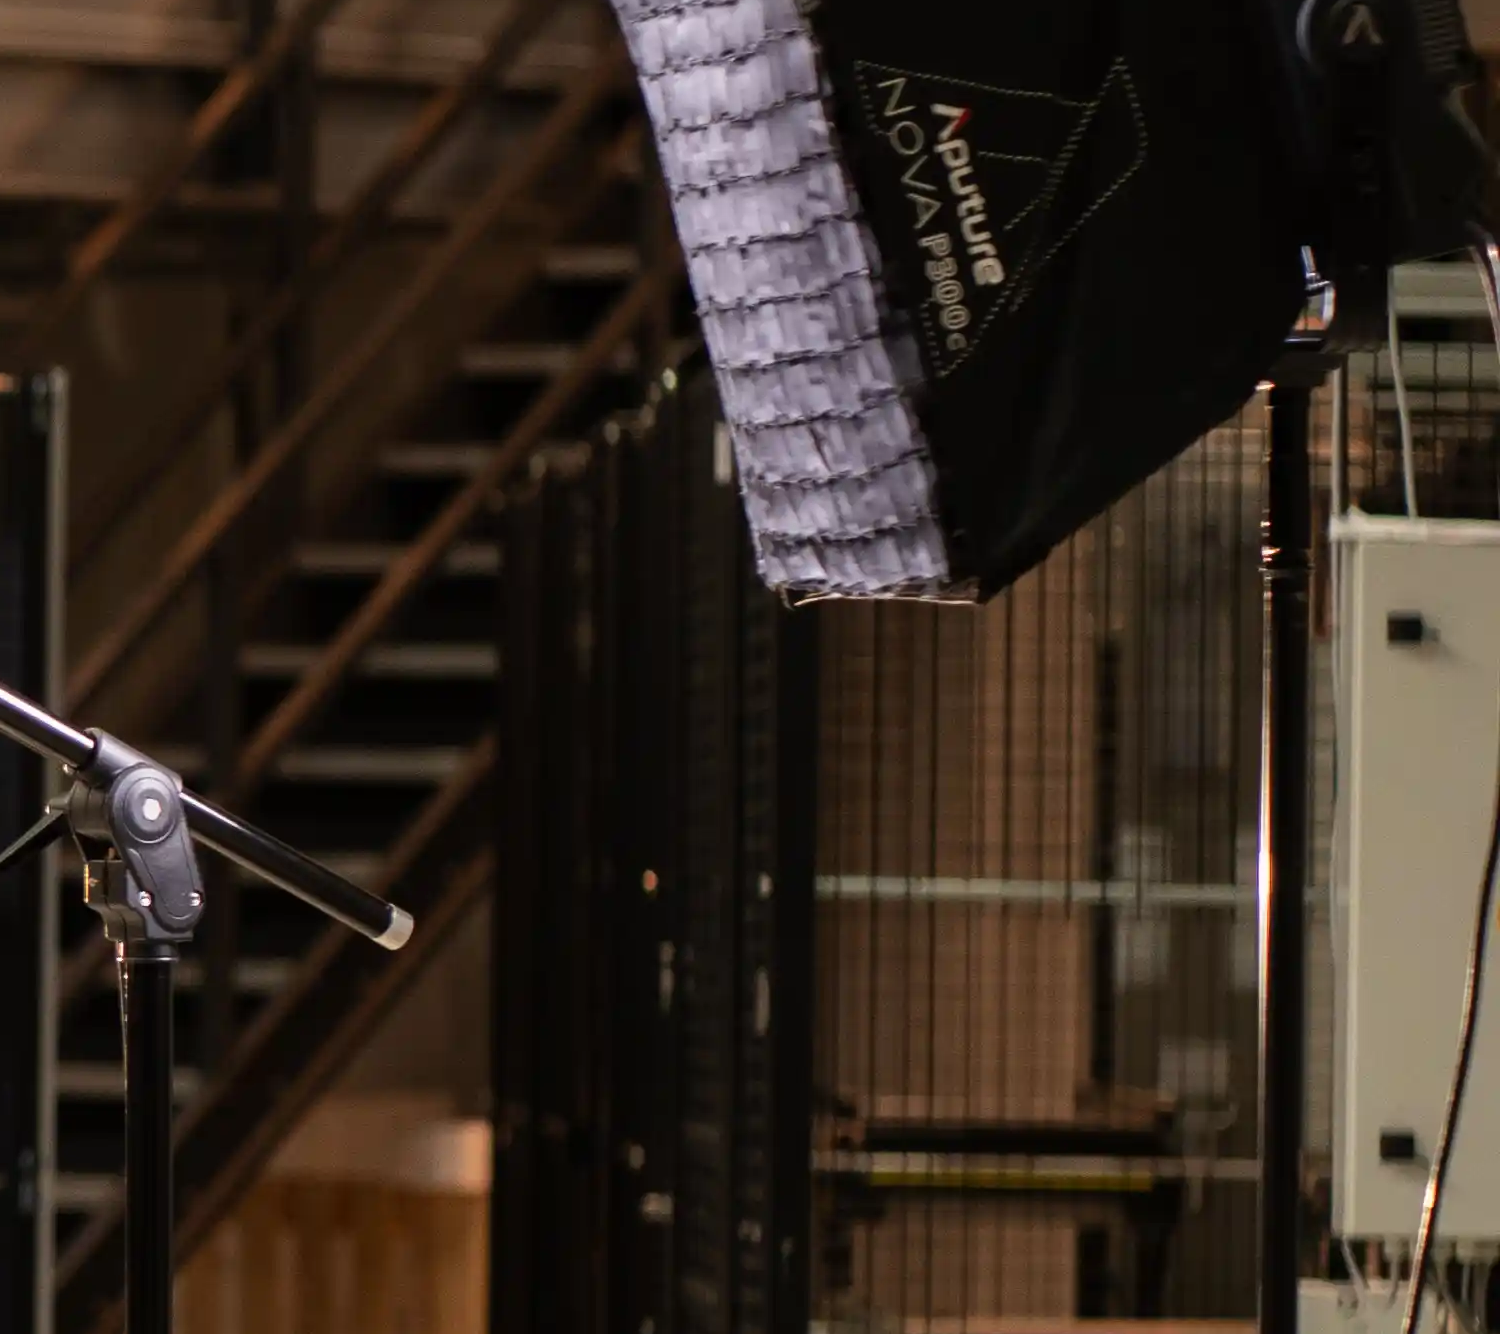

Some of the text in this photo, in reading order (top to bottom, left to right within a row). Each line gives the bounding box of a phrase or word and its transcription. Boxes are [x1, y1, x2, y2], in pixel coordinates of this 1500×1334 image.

[876, 77, 971, 351] NOVA P300c
[929, 102, 1006, 286] Aputure
